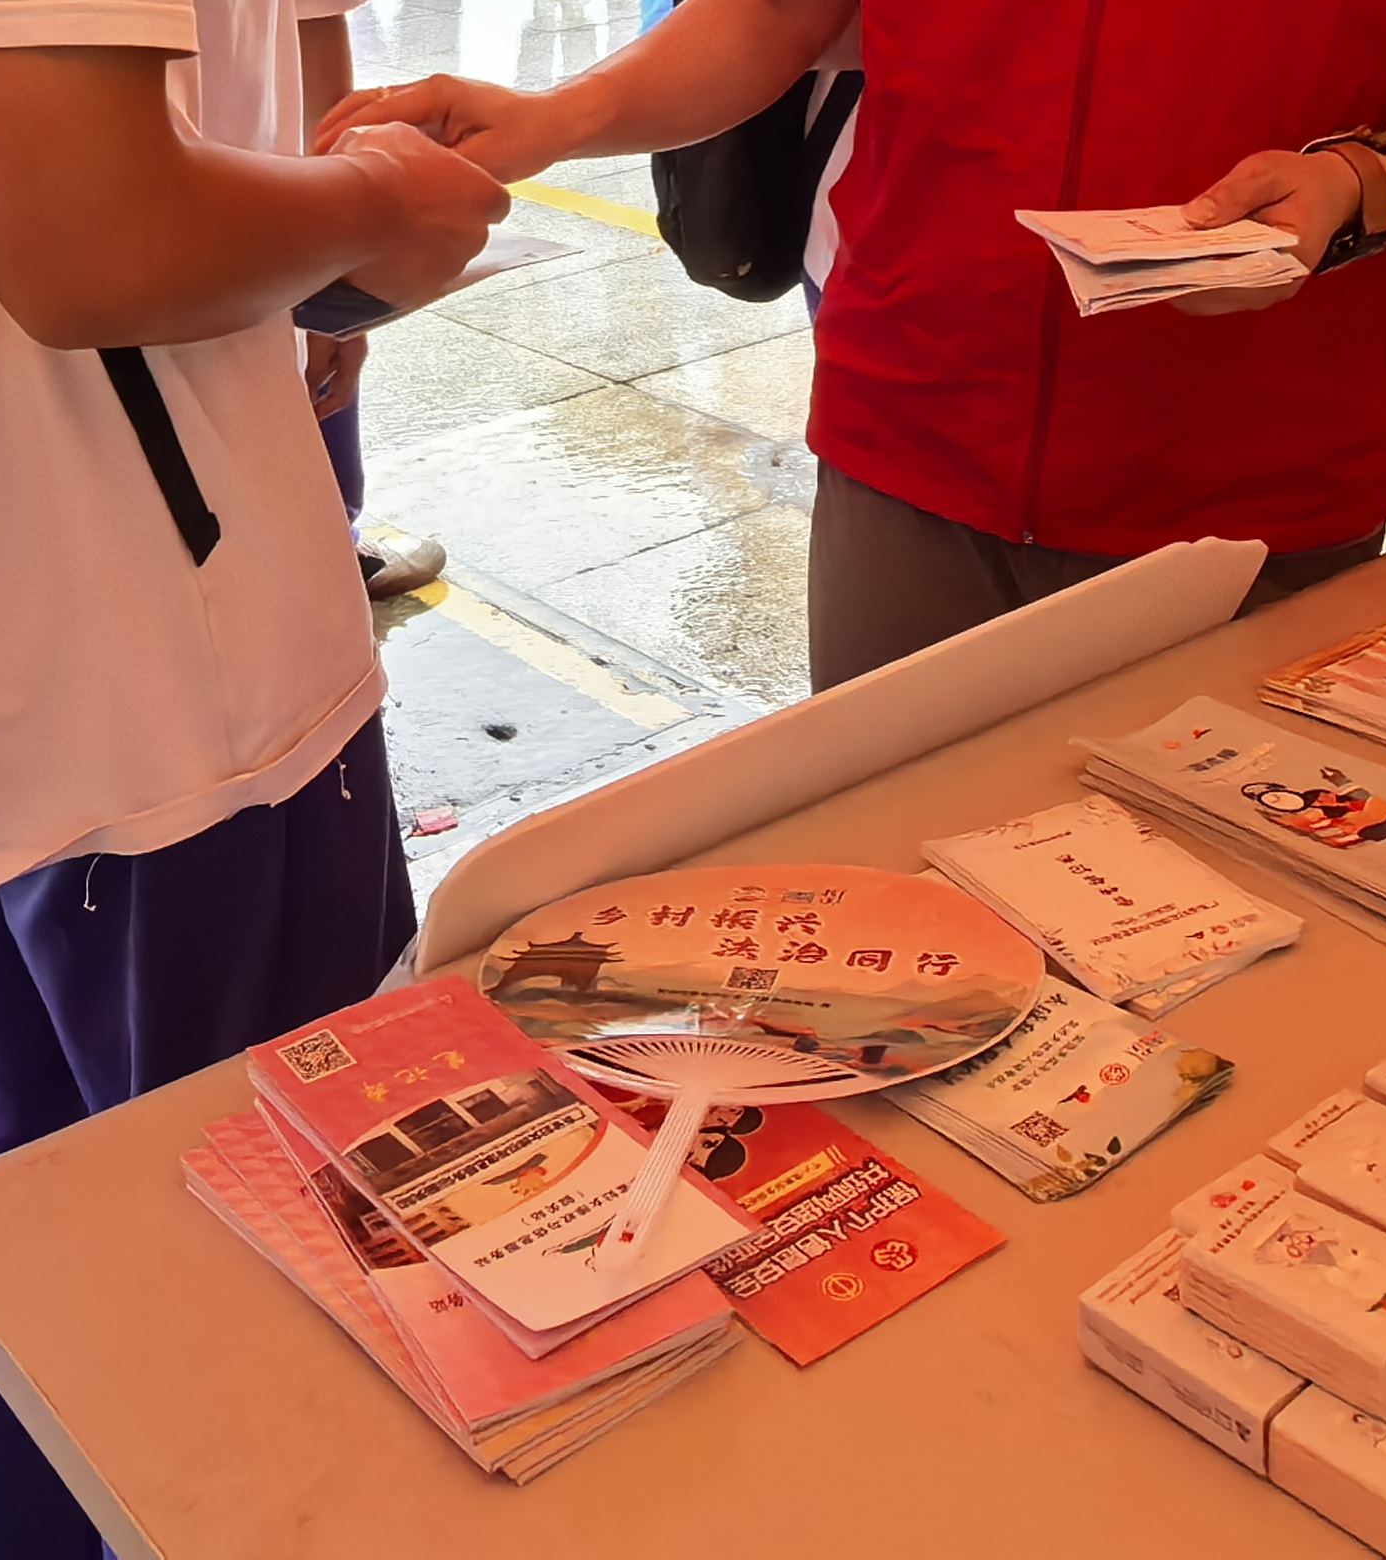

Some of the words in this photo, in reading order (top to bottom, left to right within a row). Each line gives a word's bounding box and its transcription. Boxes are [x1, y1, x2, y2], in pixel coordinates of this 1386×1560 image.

[591, 905, 822, 935] 乡村振兴
[712, 936, 961, 977] 法治同行
[729, 1181, 922, 1300] 保护个人信息安全
